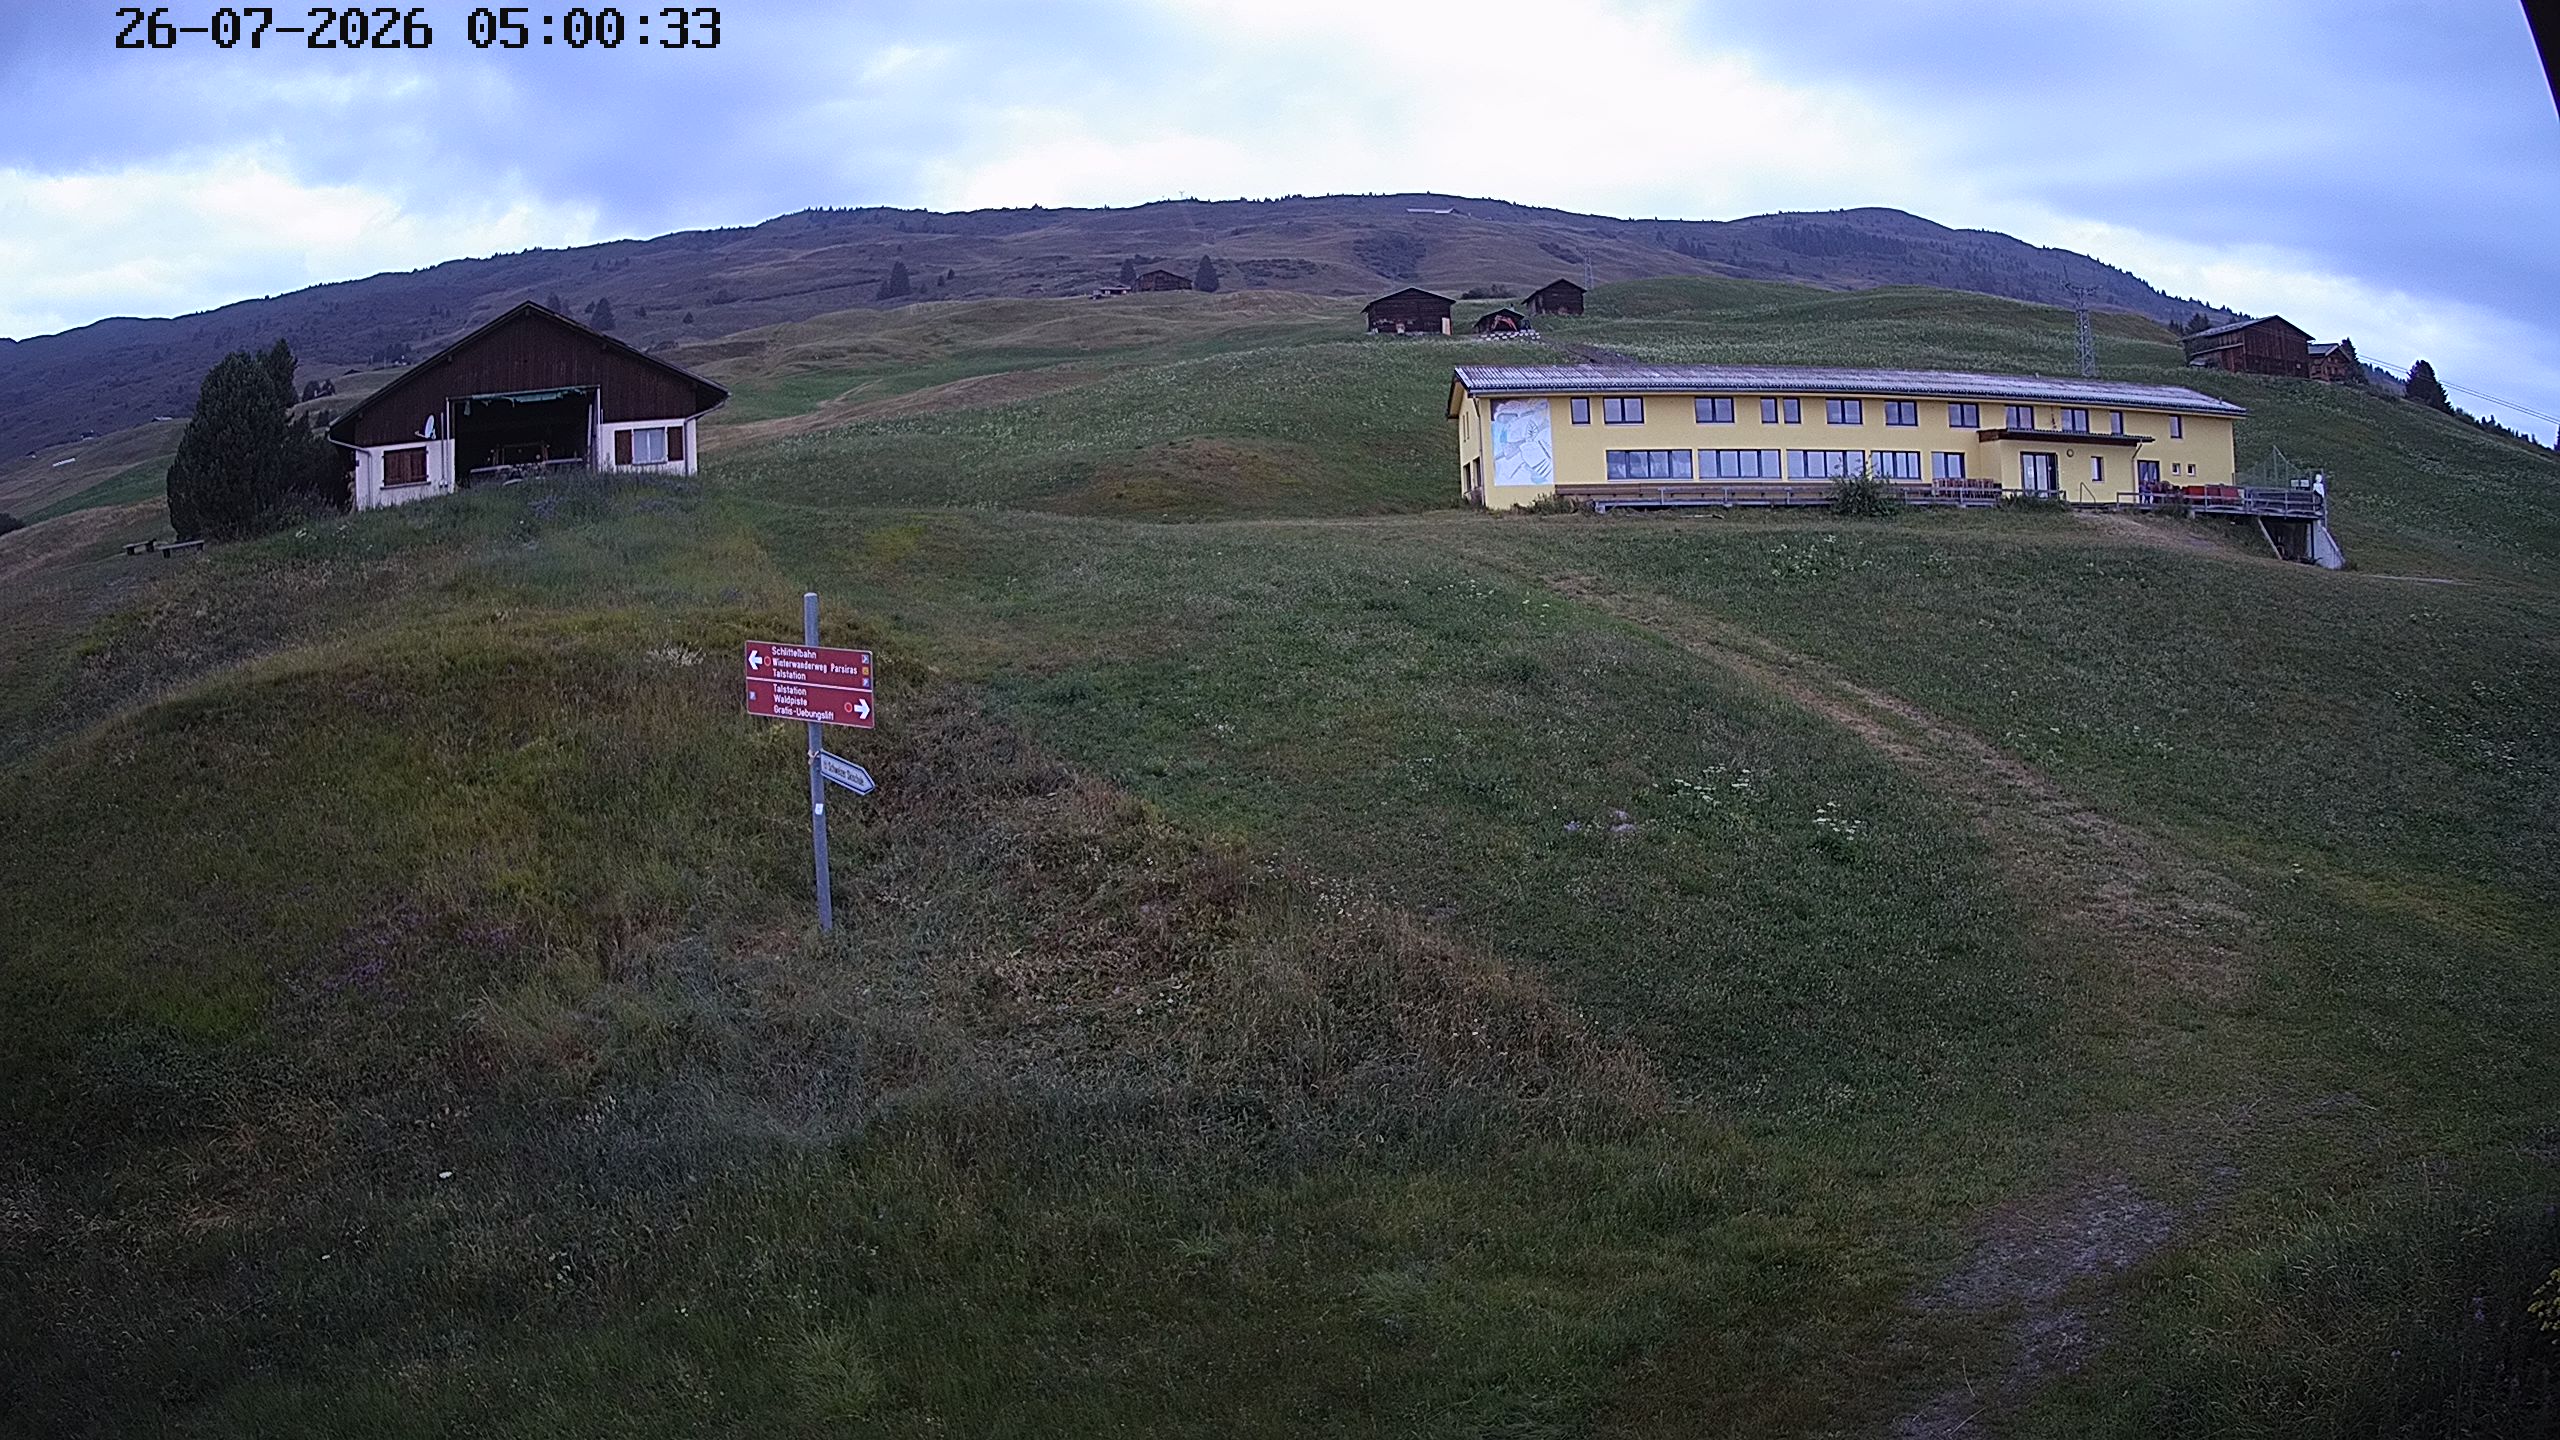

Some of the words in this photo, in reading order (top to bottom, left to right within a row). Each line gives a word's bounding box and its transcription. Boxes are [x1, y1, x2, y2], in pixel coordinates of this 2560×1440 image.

[771, 646, 817, 659] Schlittelbahn
[772, 658, 828, 673] Winterwanderweg
[772, 668, 807, 680] Talstation
[773, 683, 807, 696] Talstation
[773, 694, 808, 706] Waldpiste
[773, 704, 834, 720] Gratis-Uebungslift
